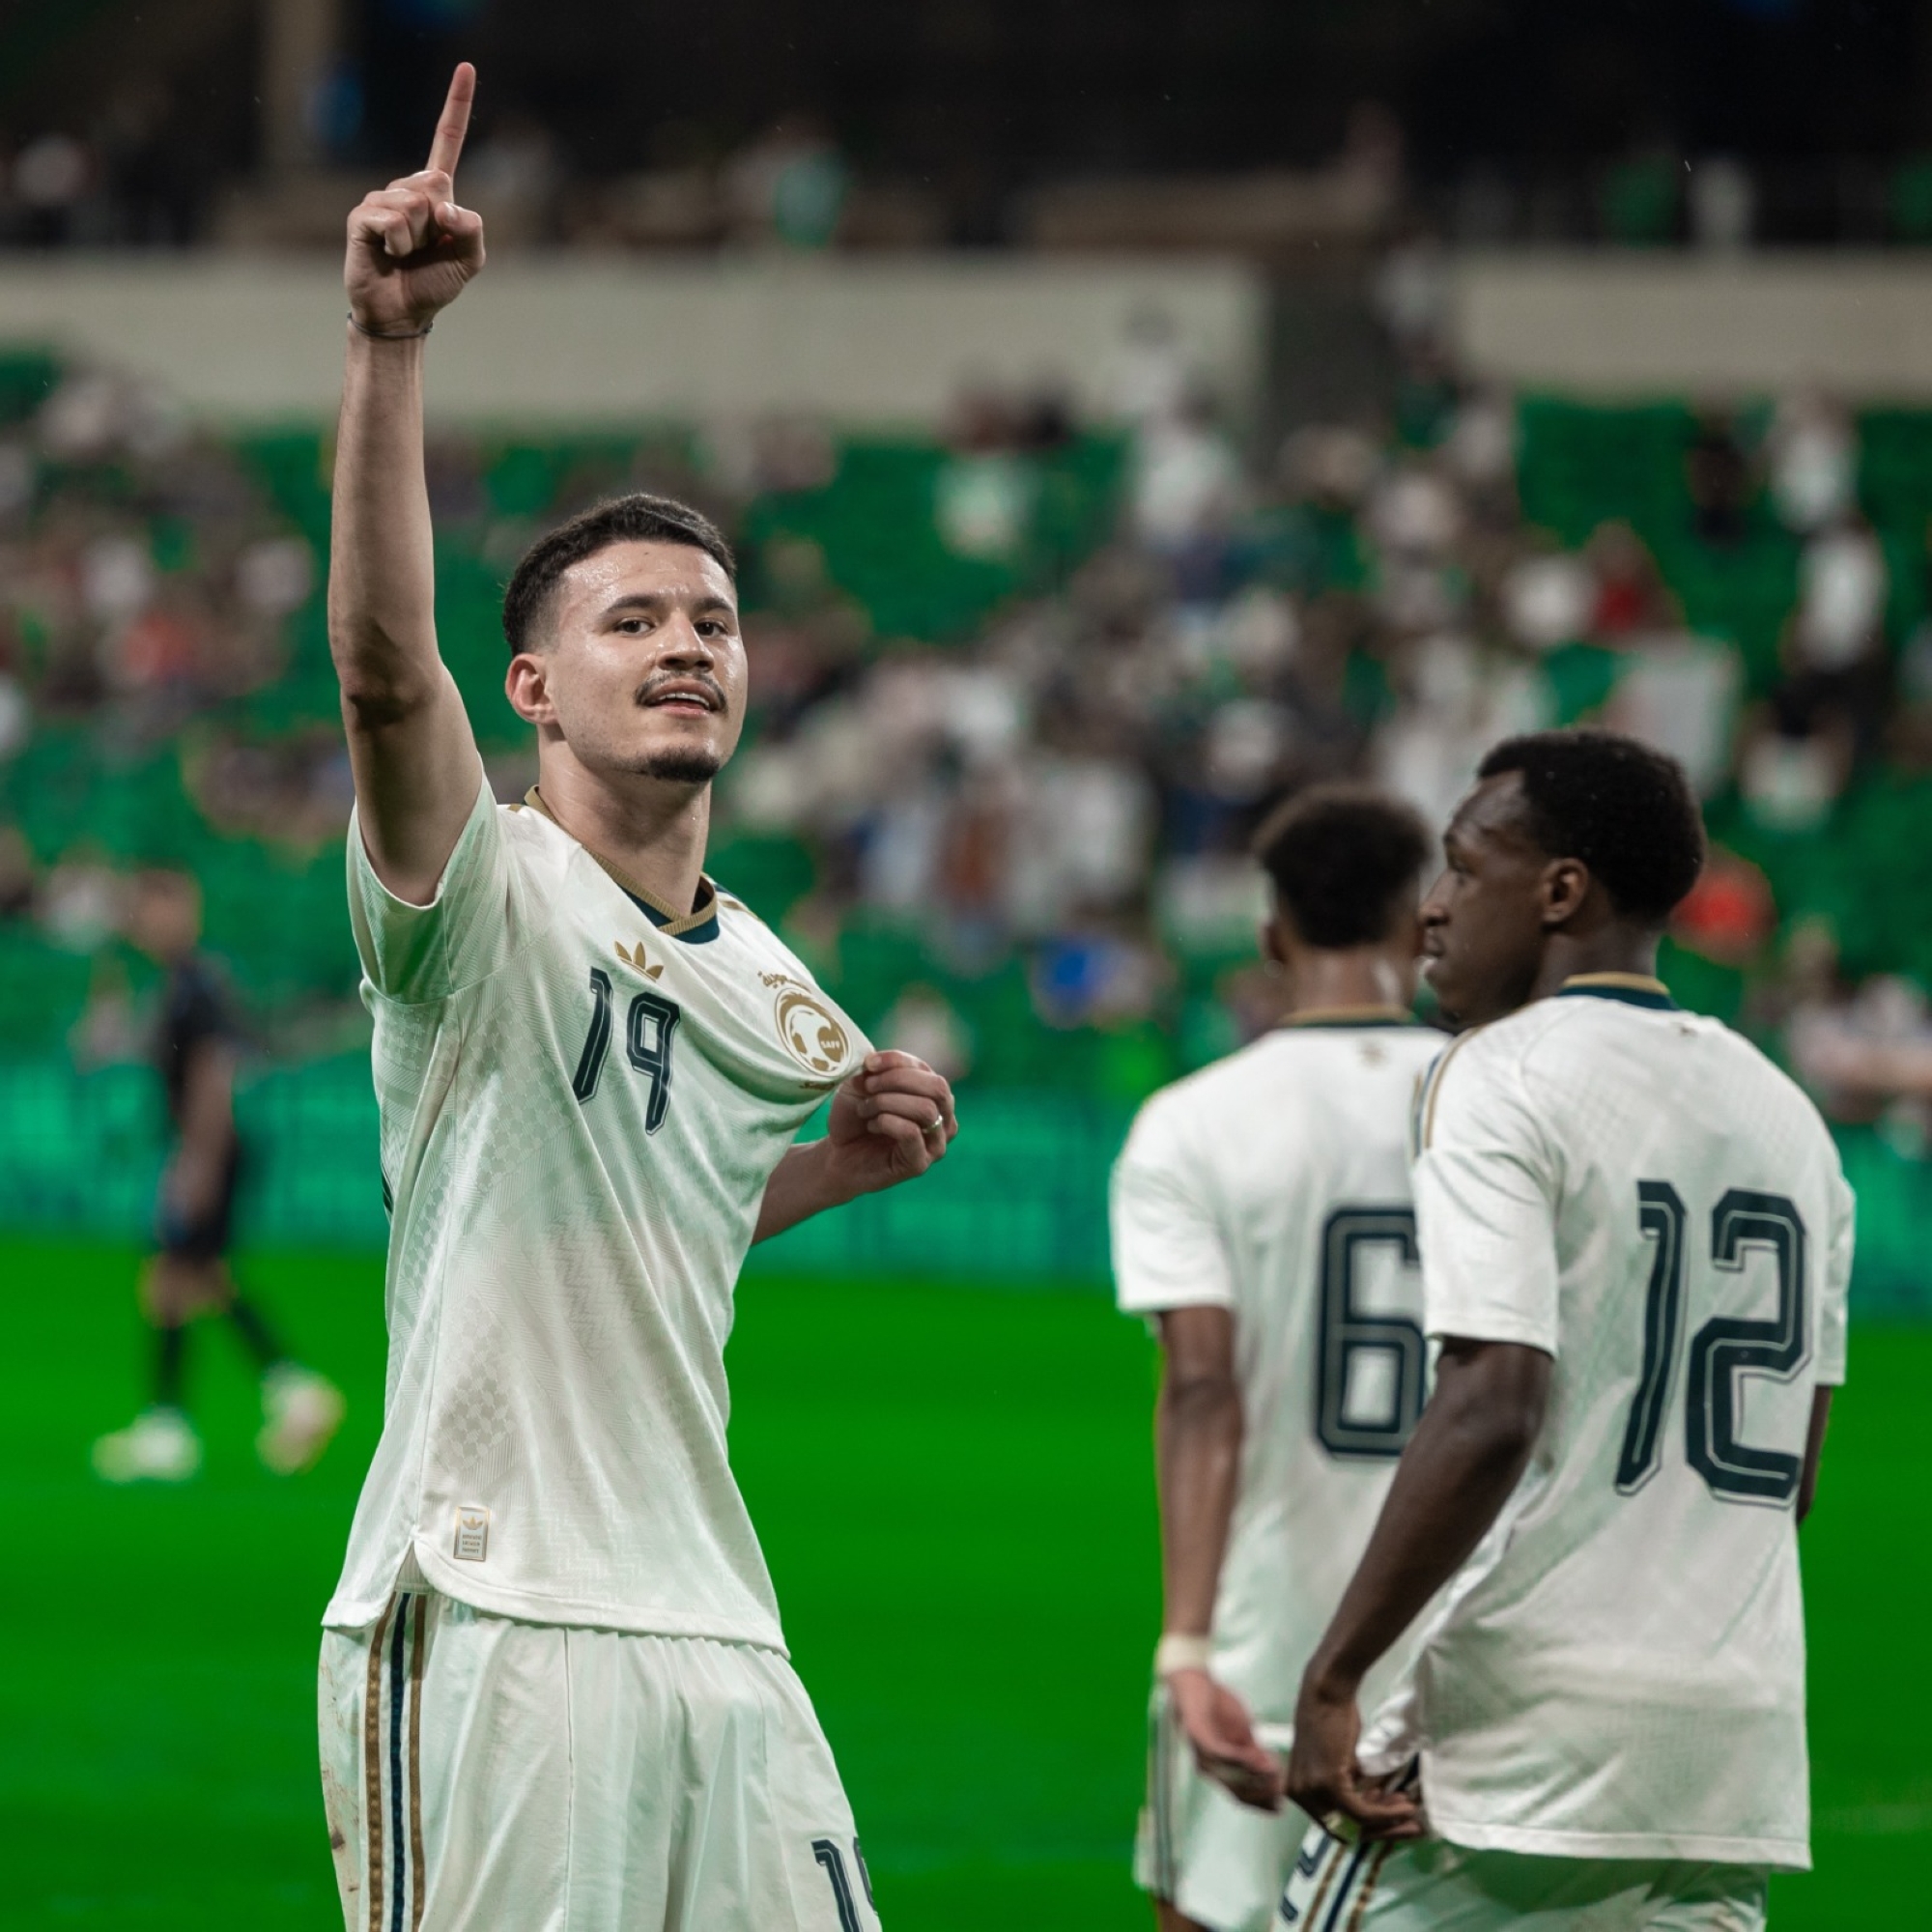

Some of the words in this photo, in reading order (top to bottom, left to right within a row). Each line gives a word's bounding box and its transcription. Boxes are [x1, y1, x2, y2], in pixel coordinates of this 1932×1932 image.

[572, 966, 680, 1136] 19
[1316, 1207, 1425, 1460] 6
[1614, 1179, 1811, 1509] 12
